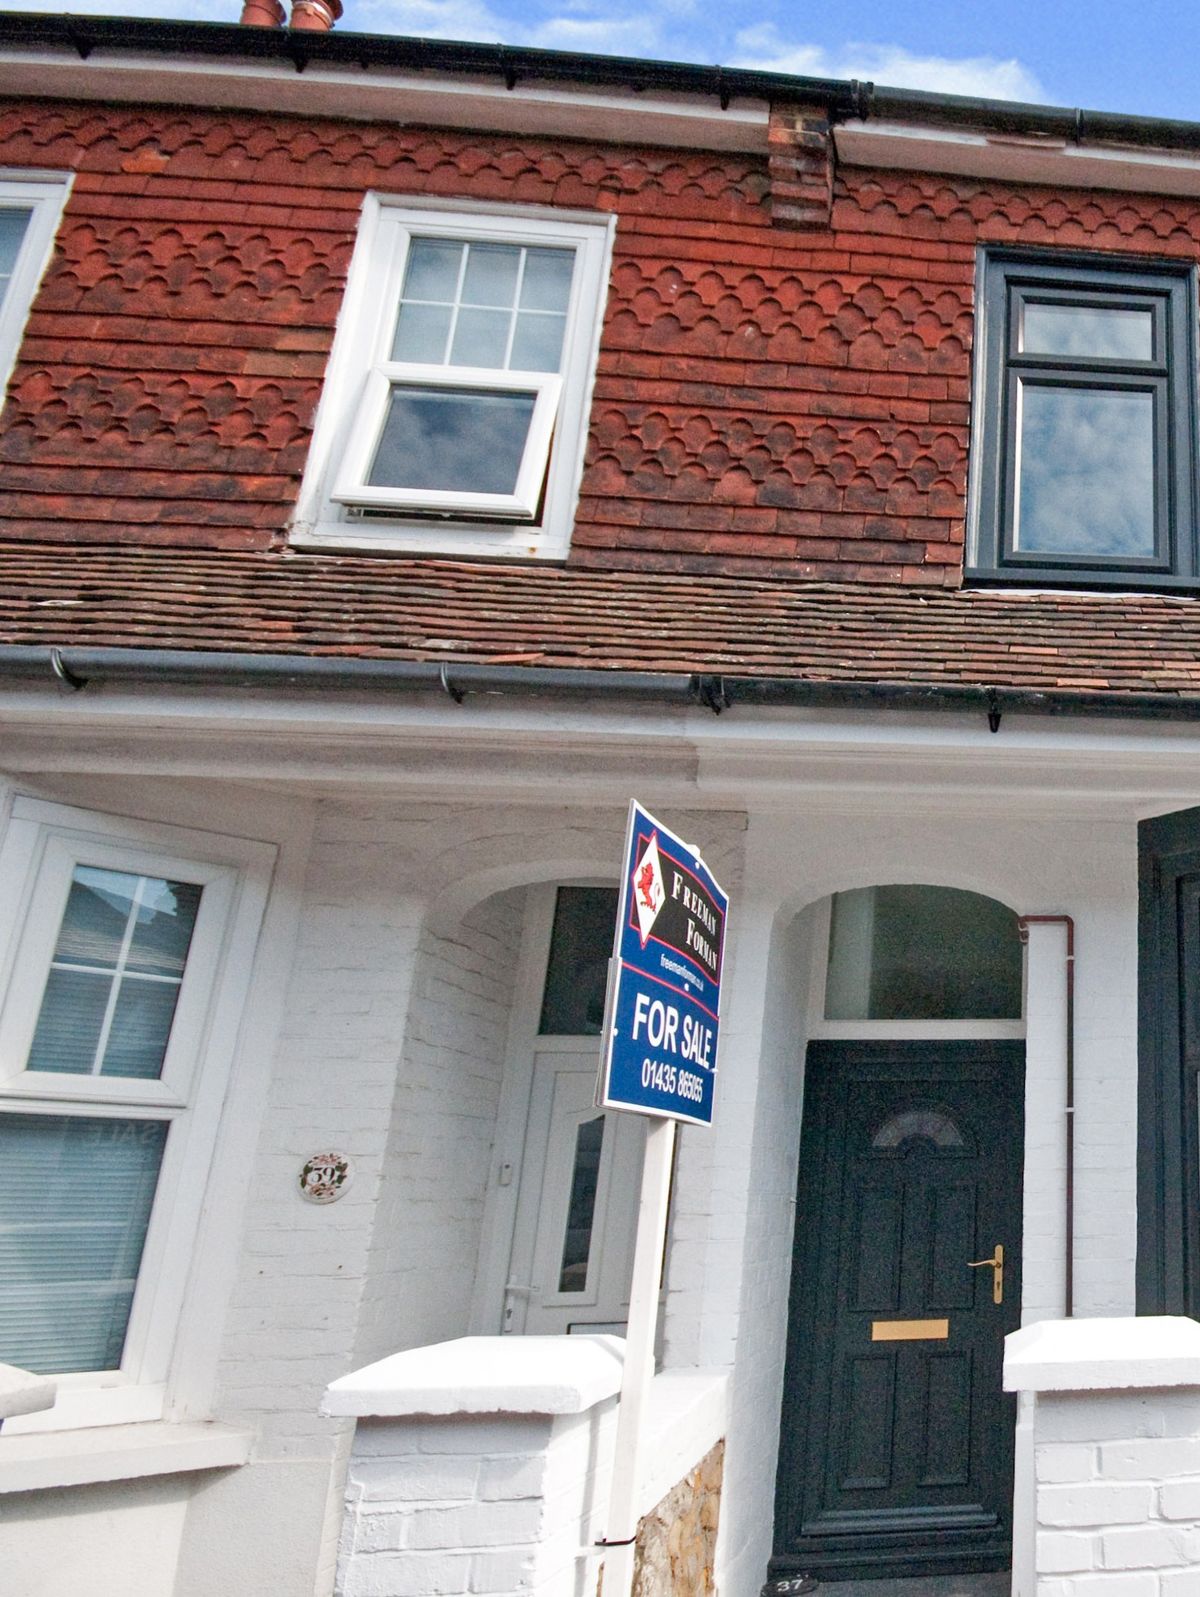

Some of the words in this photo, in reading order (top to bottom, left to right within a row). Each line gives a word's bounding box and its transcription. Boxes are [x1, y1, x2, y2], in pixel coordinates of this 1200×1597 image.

[671, 871, 717, 936] FREEMAN
[686, 918, 717, 971] FORMAN
[632, 992, 679, 1053] FOR
[681, 1015, 712, 1070] SALE
[641, 1058, 677, 1094] 01435
[777, 1579, 803, 1592] 37
